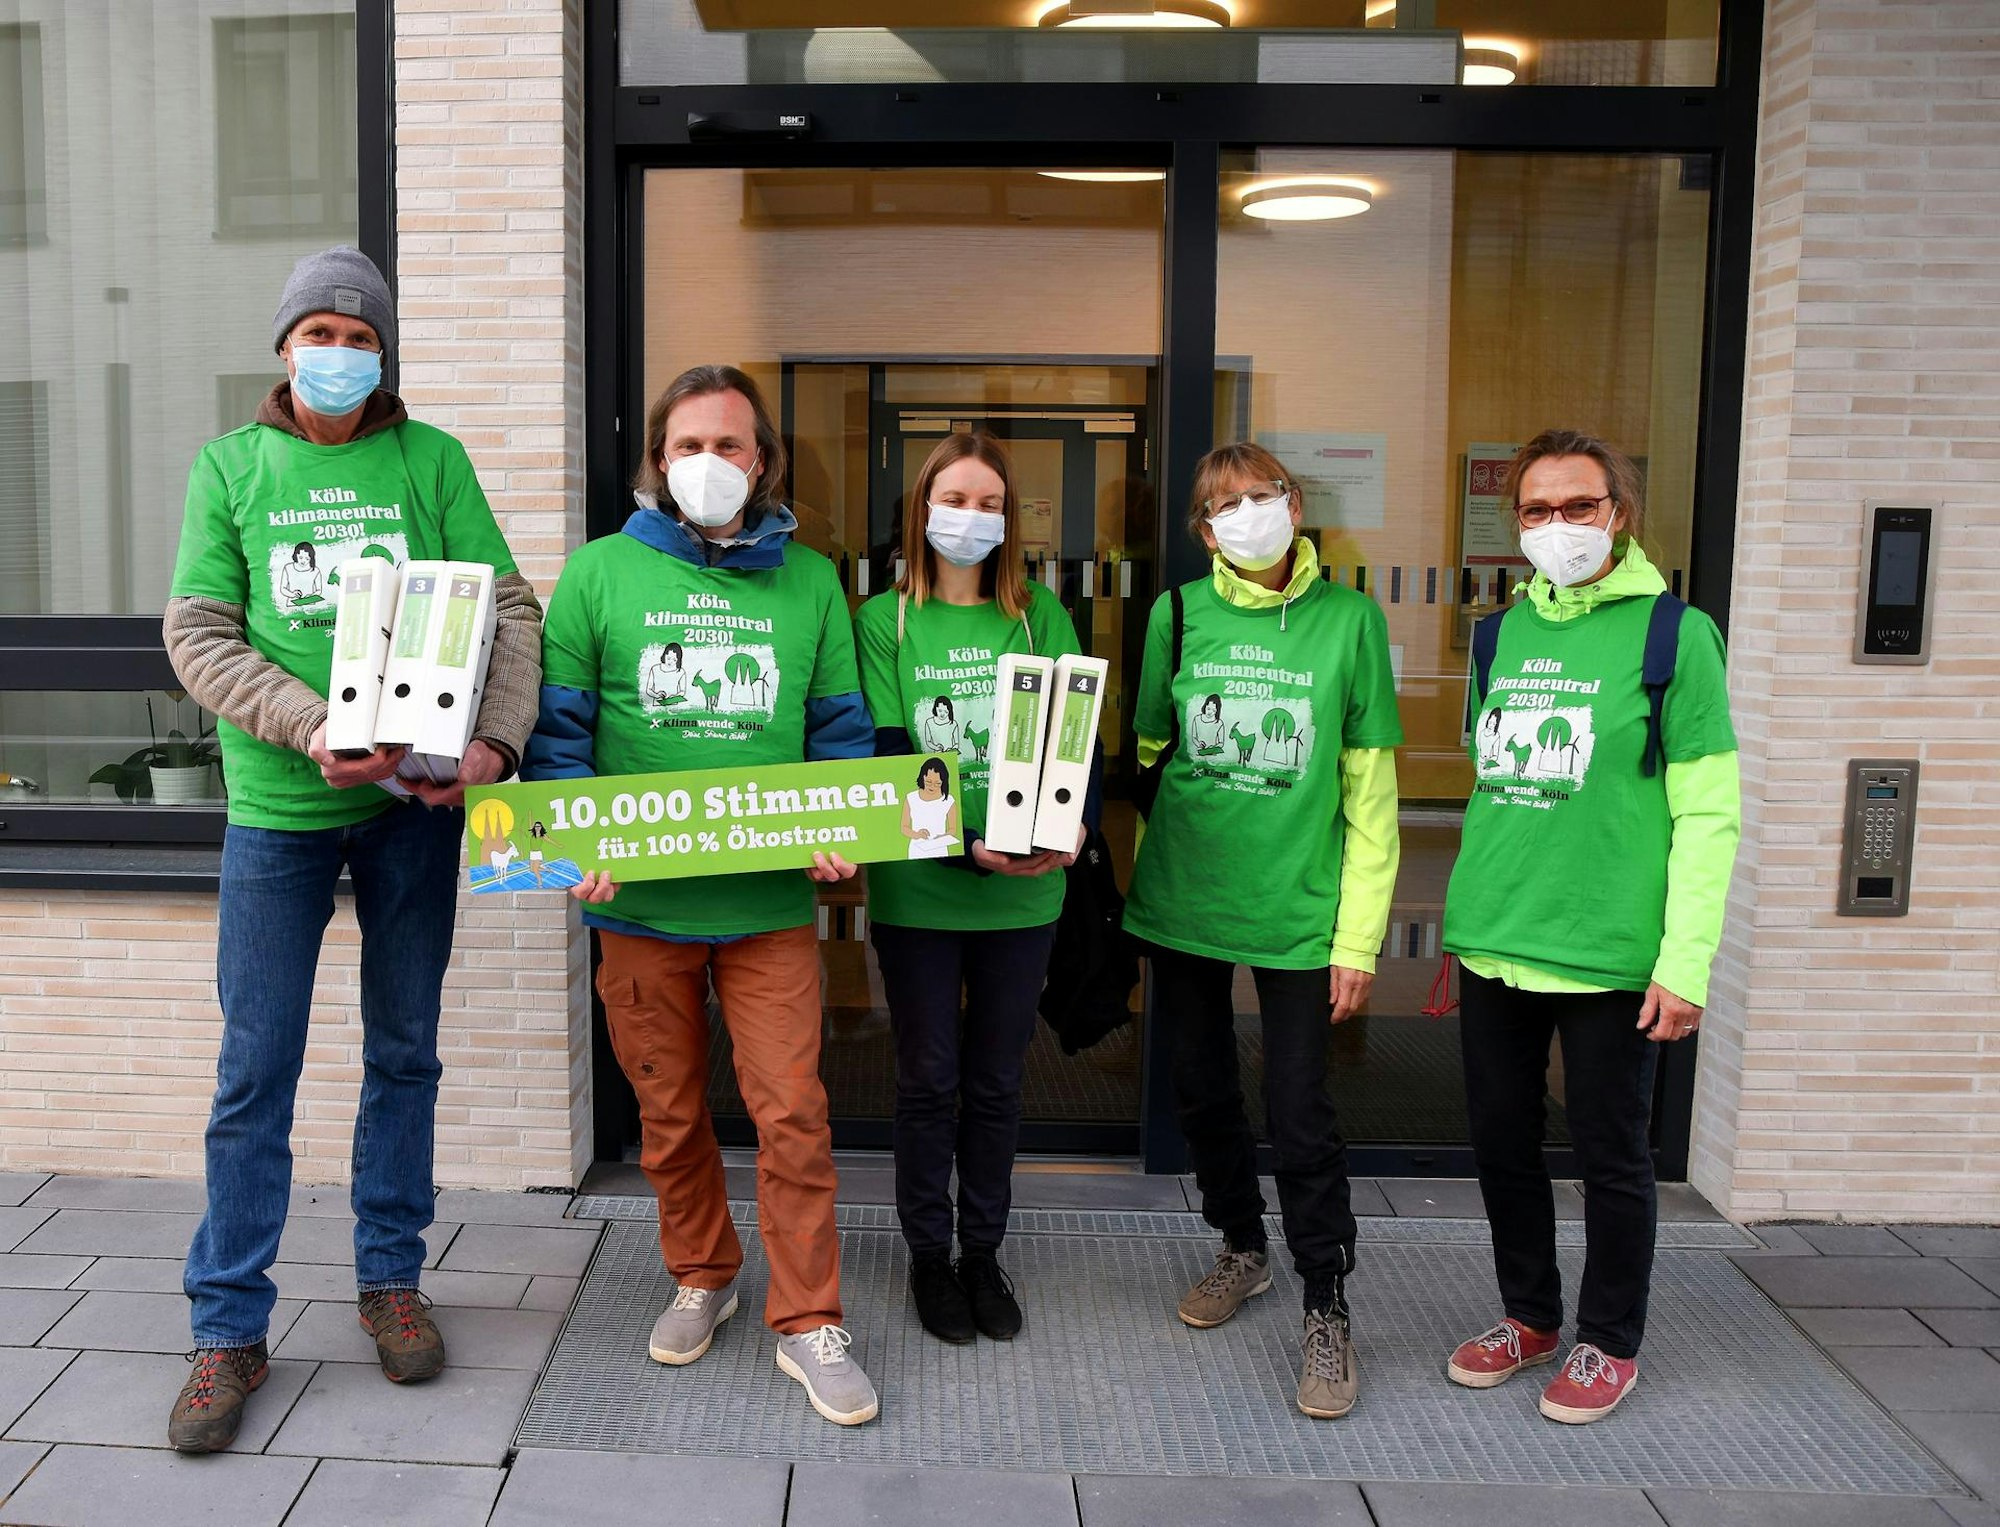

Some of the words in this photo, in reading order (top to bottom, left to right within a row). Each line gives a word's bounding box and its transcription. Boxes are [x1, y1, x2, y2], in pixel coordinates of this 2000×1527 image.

[308, 487, 358, 503] Köln
[268, 504, 402, 526] klimaneutral
[313, 523, 366, 540] 2030!
[354, 578, 362, 591] 1
[415, 580, 426, 592] 3
[458, 583, 471, 596] 2
[687, 594, 731, 610] Köln
[644, 611, 773, 633] klimaneutral
[684, 628, 734, 644] 2030!
[947, 647, 992, 663] Köln
[1229, 644, 1274, 664] Köln
[1520, 658, 1562, 673] Köln
[1021, 676, 1033, 690] 5
[1193, 663, 1313, 687] klimaneutral
[1076, 677, 1089, 691] 4
[1223, 680, 1274, 700] 2030!
[1505, 693, 1556, 708] 2030!
[663, 719, 735, 729] Klimawende
[737, 721, 763, 731] Köln
[1266, 777, 1292, 789] Köln
[1477, 783, 1540, 797] Klimawende
[1541, 788, 1569, 800] Köln
[550, 789, 692, 830] 10.000
[704, 781, 899, 819] Stimmen
[597, 837, 639, 860] für
[647, 833, 693, 856] 100
[697, 831, 719, 853] %
[727, 824, 858, 850] Ökostrom
